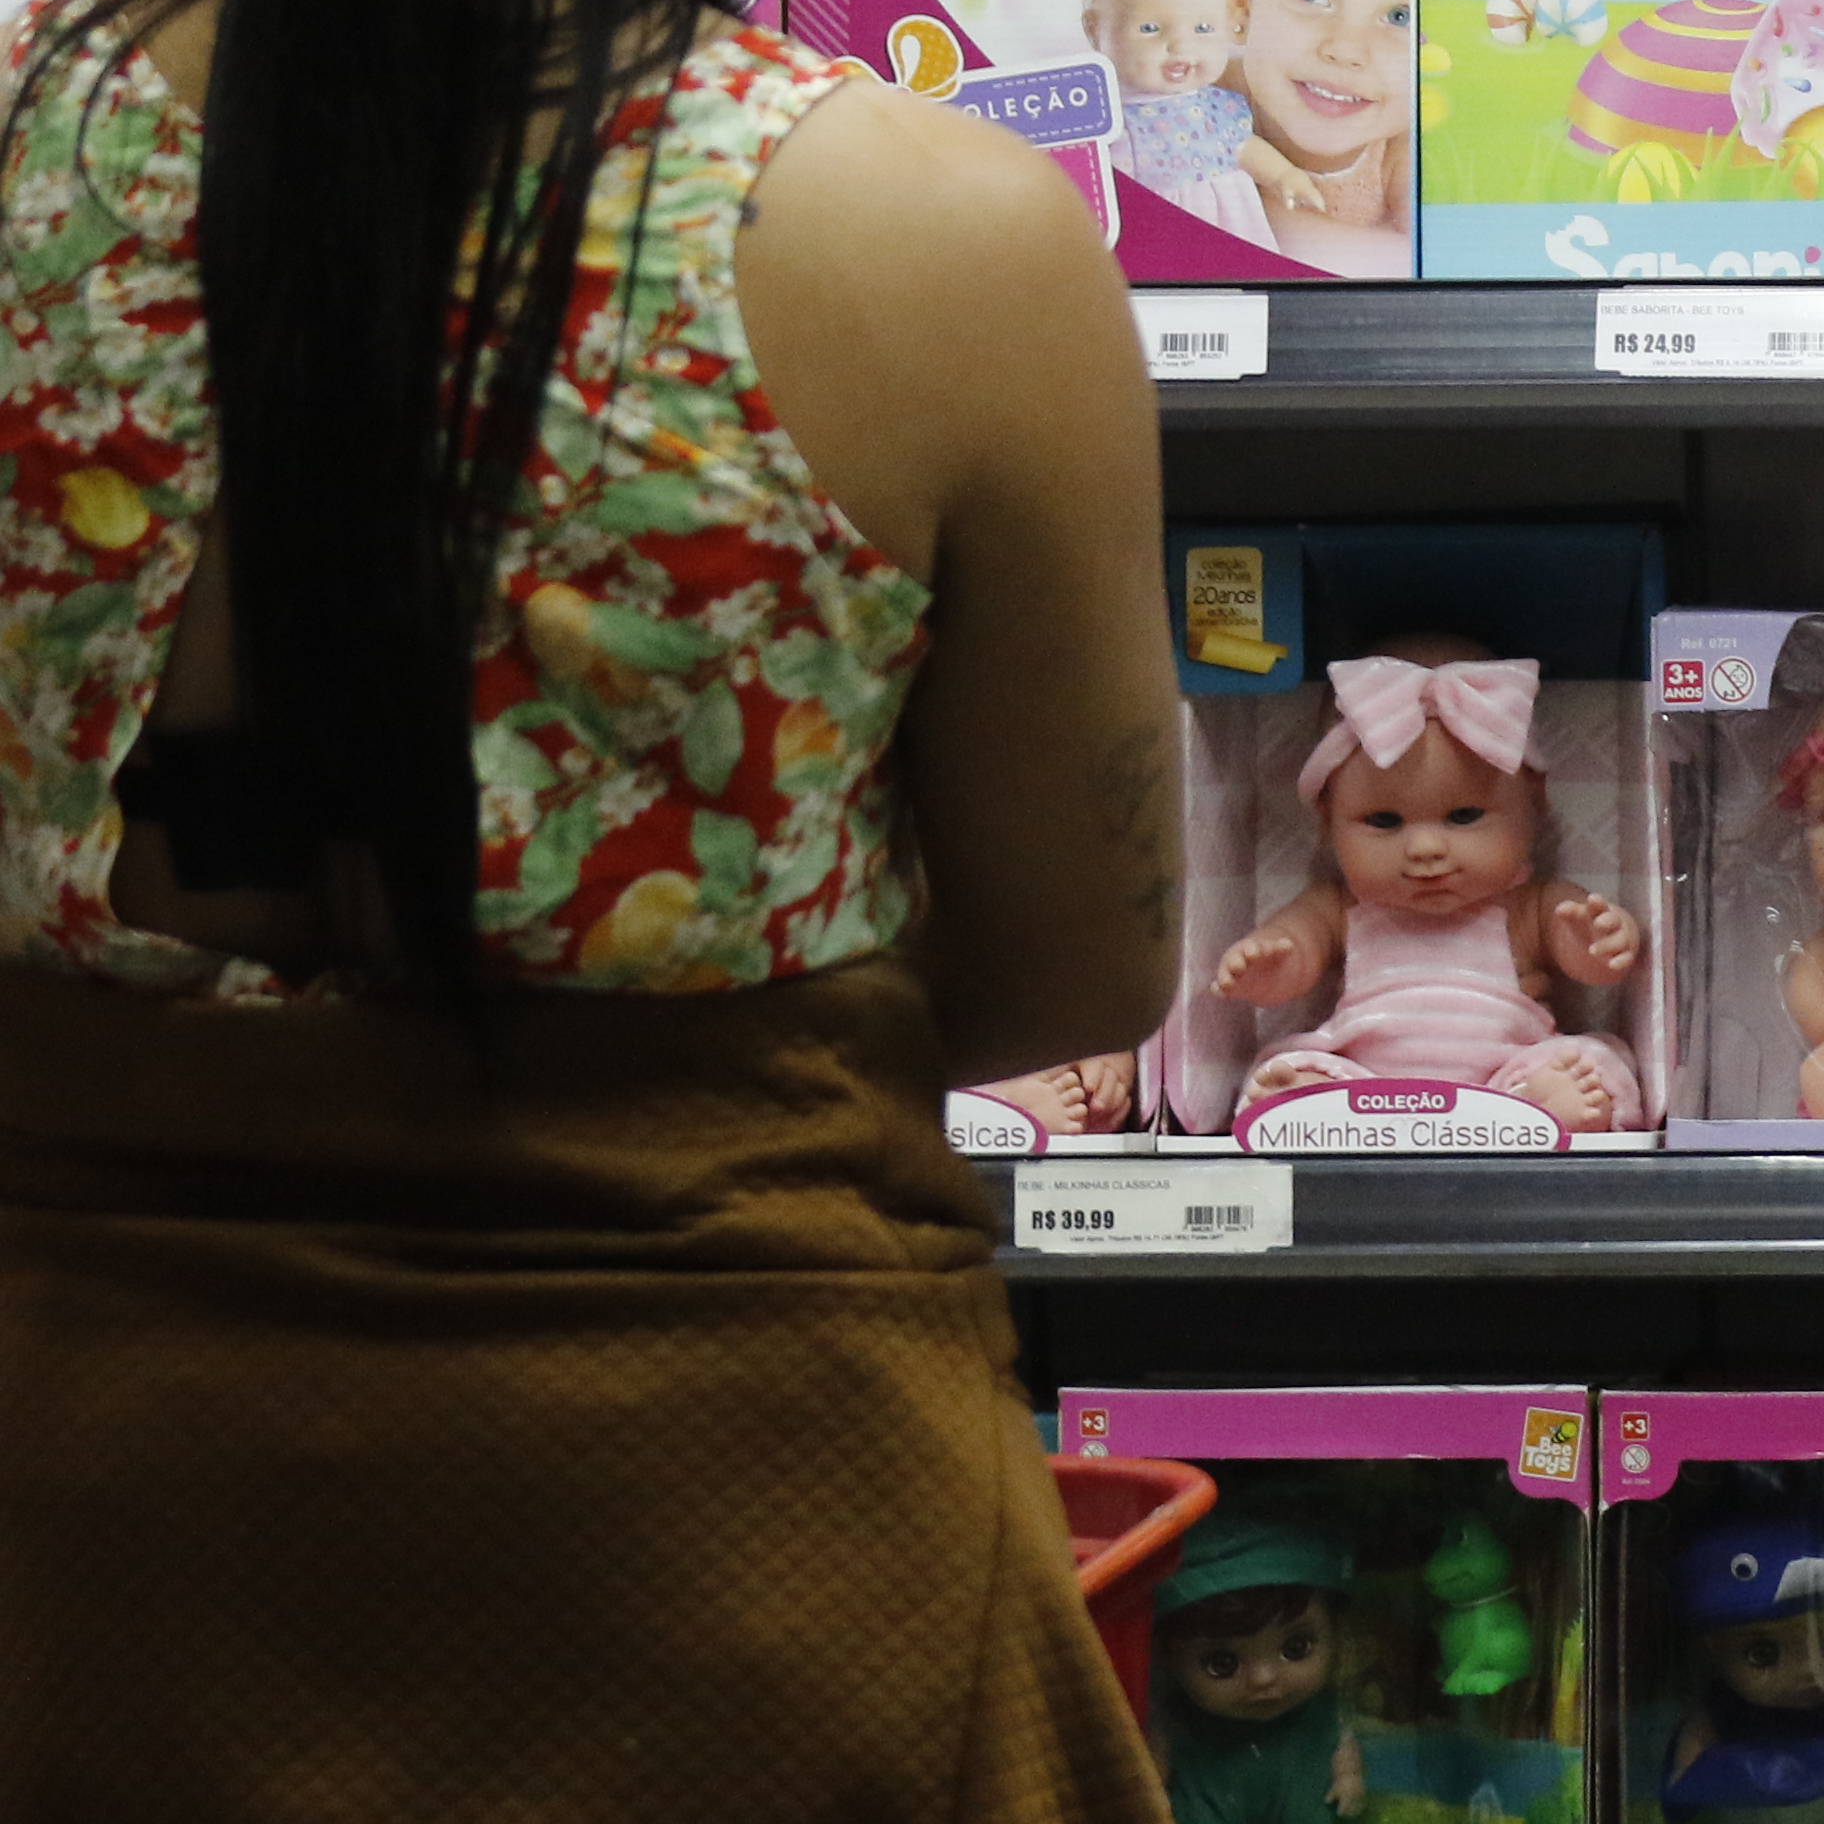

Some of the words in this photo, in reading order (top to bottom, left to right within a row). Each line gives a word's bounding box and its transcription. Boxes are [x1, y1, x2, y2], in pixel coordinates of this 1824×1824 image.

[963, 87, 1088, 119] OLEÇÃO
[1614, 334, 1638, 354] R$
[1644, 333, 1695, 354] 24,99
[1668, 664, 1698, 685] 3+
[1664, 687, 1703, 699] ANOS
[1357, 1090, 1445, 1114] COLEÇÃO
[1258, 1119, 1397, 1148] Milkinhas
[1410, 1117, 1550, 1147] Clássicas
[1032, 1211, 1056, 1230] R$
[1061, 1210, 1114, 1231] 39,99
[1082, 1415, 1106, 1432] +3
[1623, 1418, 1647, 1435] +3
[1540, 1436, 1571, 1457] Bee
[1525, 1446, 1570, 1474] Toys
